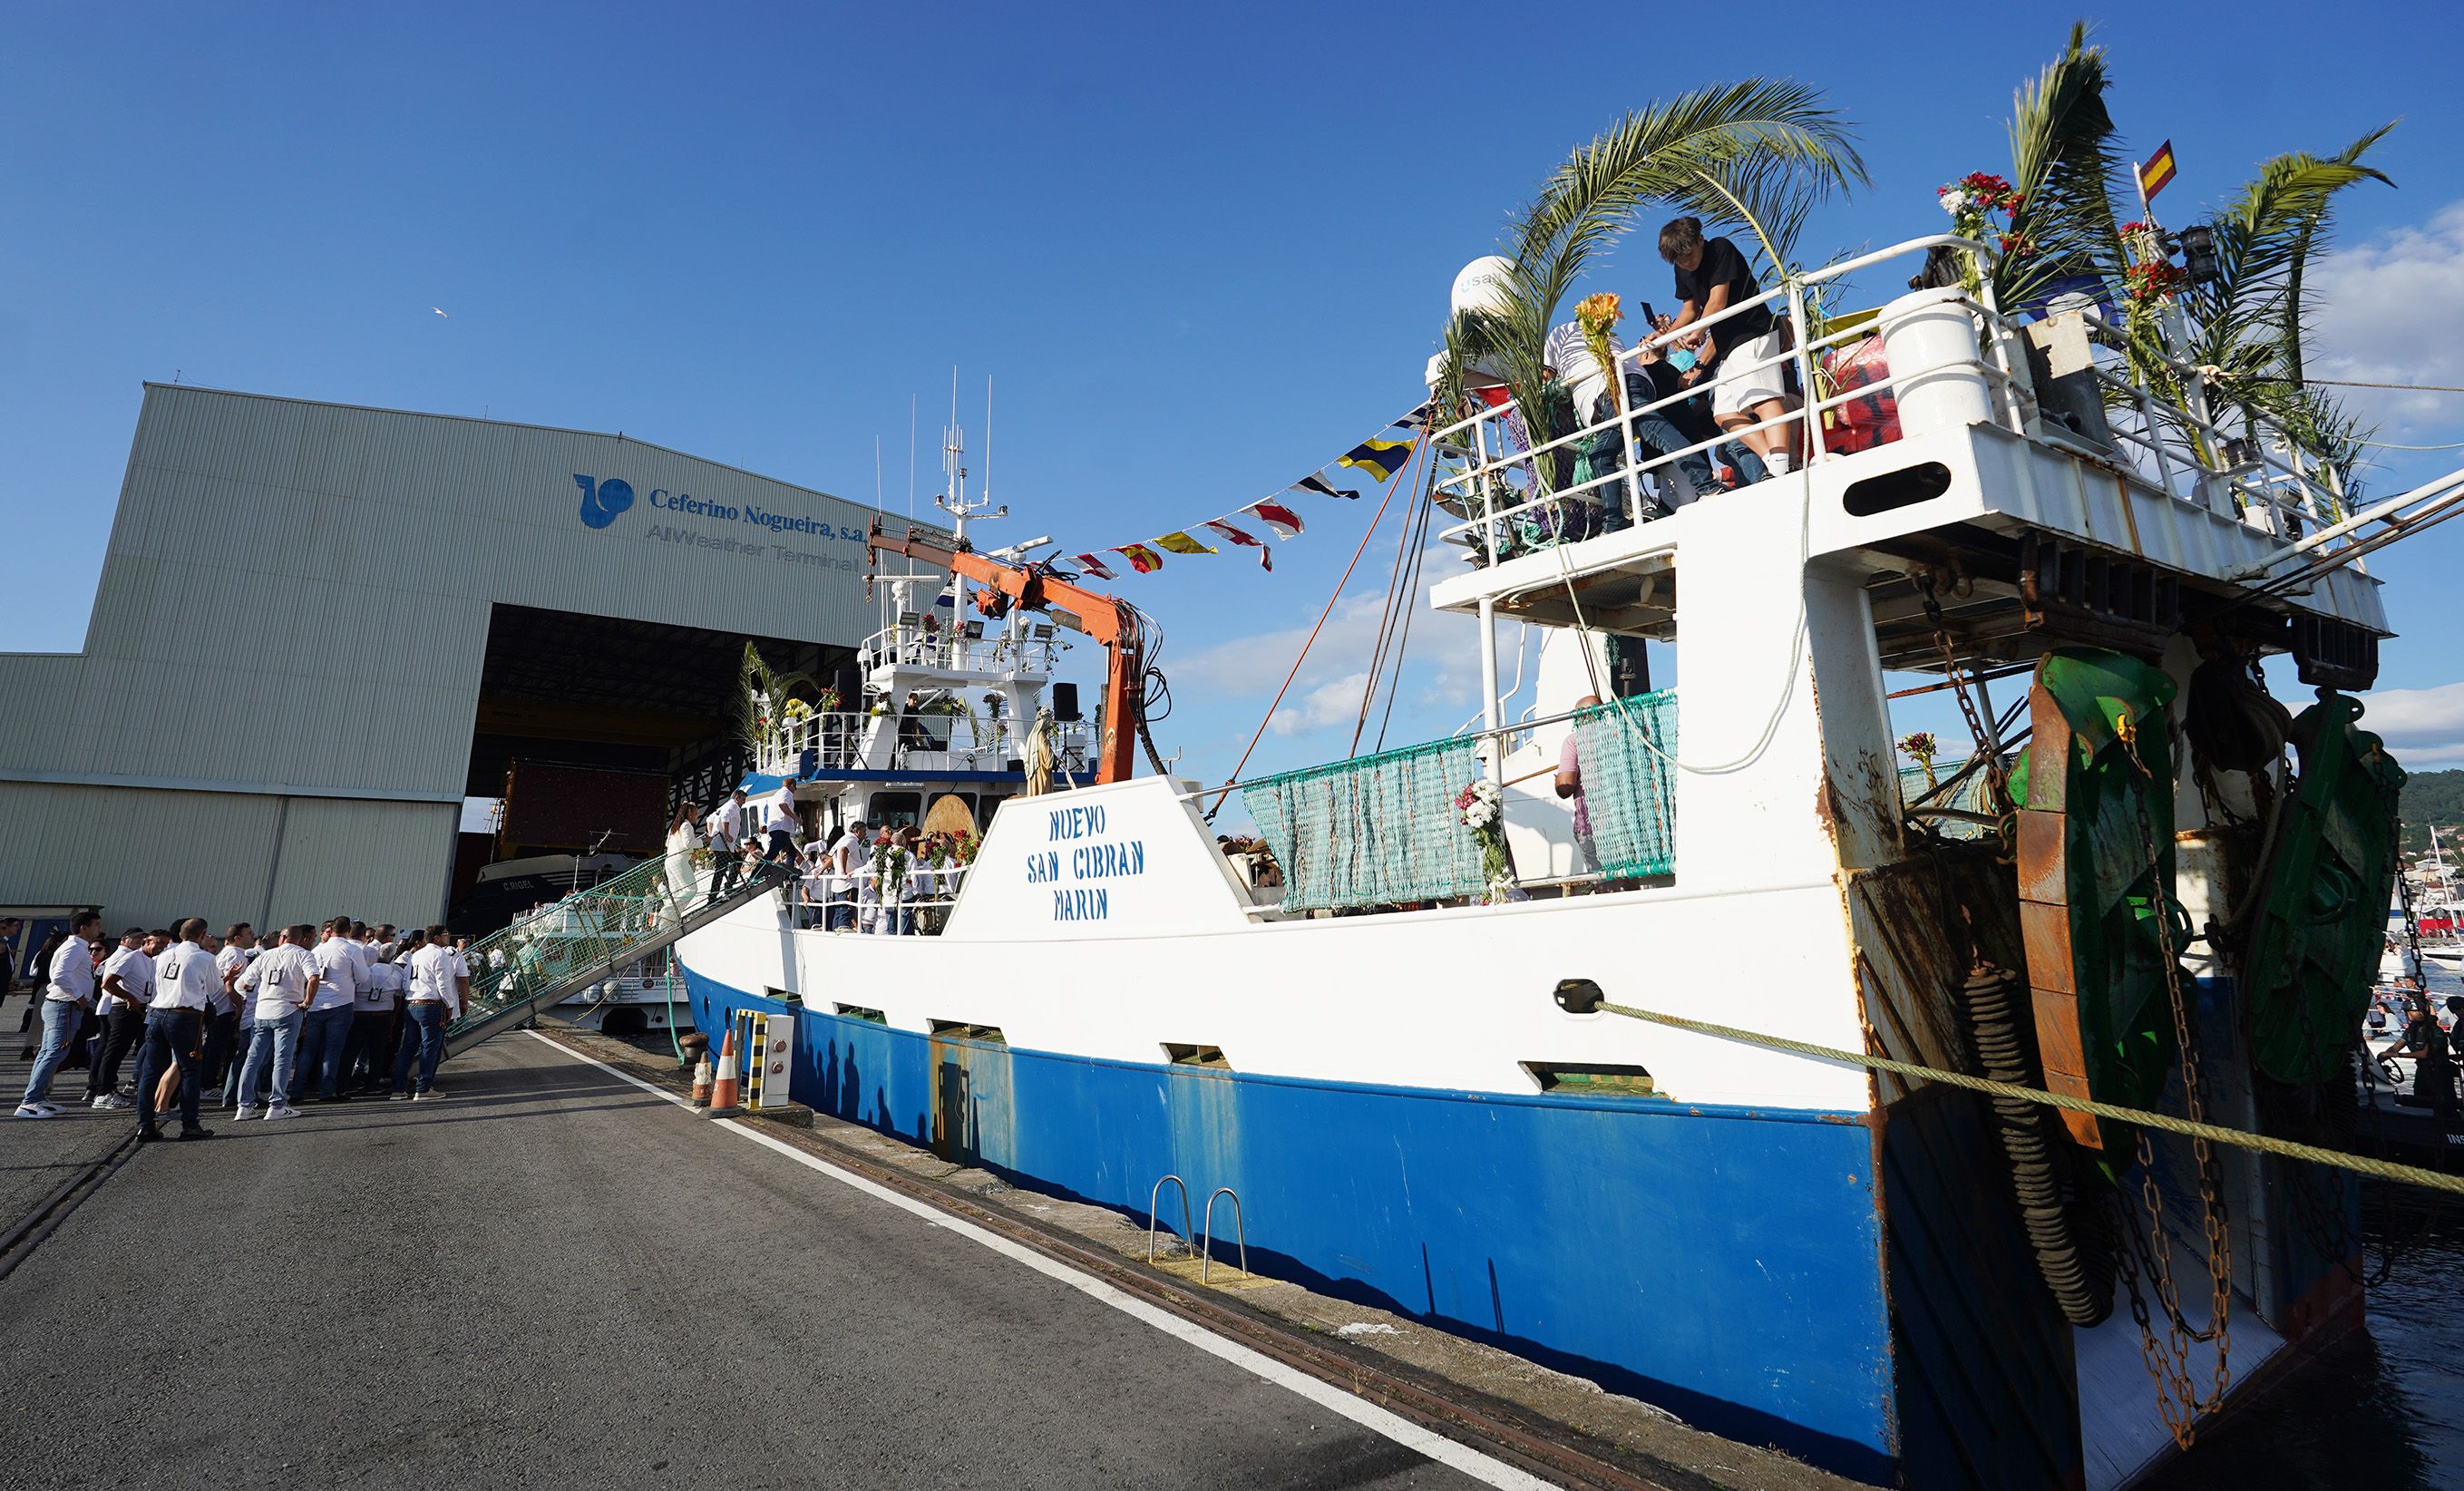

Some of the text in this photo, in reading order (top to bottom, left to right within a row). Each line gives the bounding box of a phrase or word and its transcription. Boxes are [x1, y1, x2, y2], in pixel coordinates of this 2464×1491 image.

[649, 489, 868, 543] Ceferino Nogueira, s.a.
[645, 524, 859, 573] AllWeather Terminal
[1049, 804, 1105, 842] NUEVO
[1027, 841, 1144, 883] SAN CIBRAN
[1054, 888, 1108, 921] MARIN
